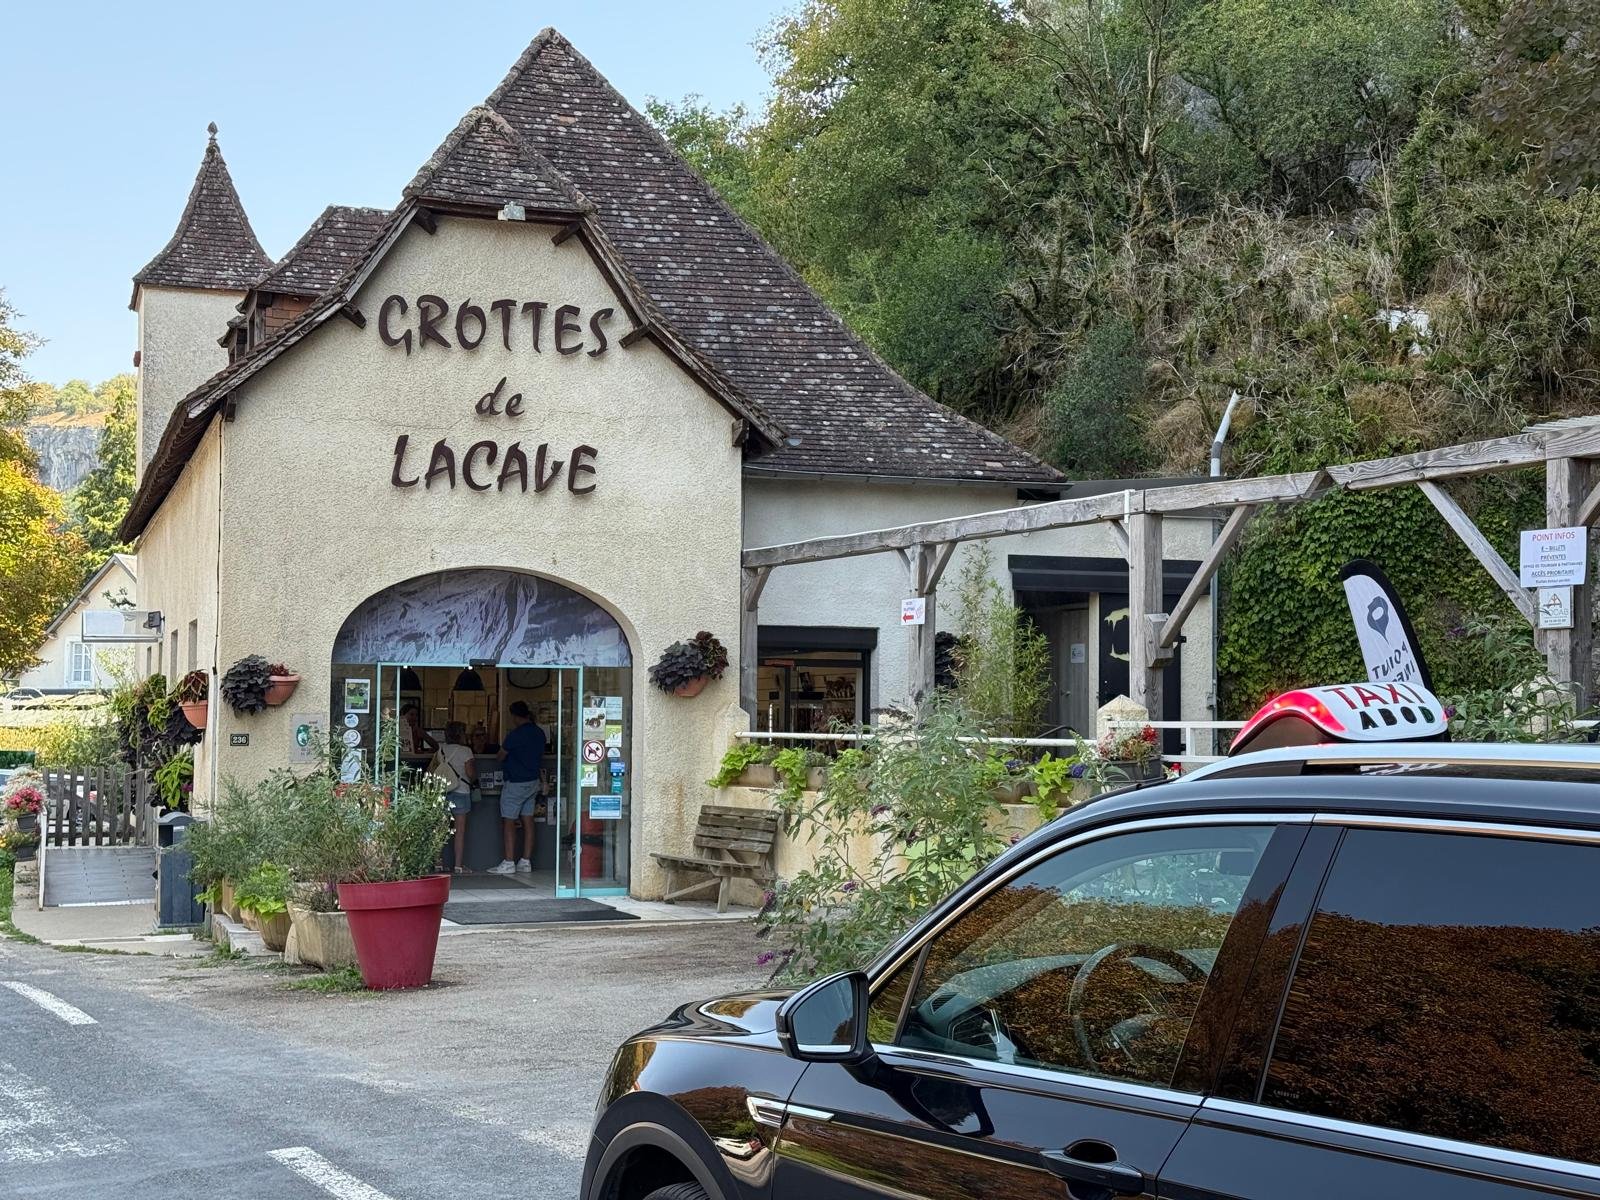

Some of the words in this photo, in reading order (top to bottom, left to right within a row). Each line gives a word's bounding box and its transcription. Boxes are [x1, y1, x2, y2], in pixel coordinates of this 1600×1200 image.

[378, 294, 614, 358] GROTTES
[475, 376, 525, 417] de
[391, 434, 598, 496] LACAVE
[1532, 532, 1553, 541] POINT
[1554, 531, 1575, 539] INFOS
[1321, 683, 1425, 710] TAXI
[232, 735, 247, 745] 236
